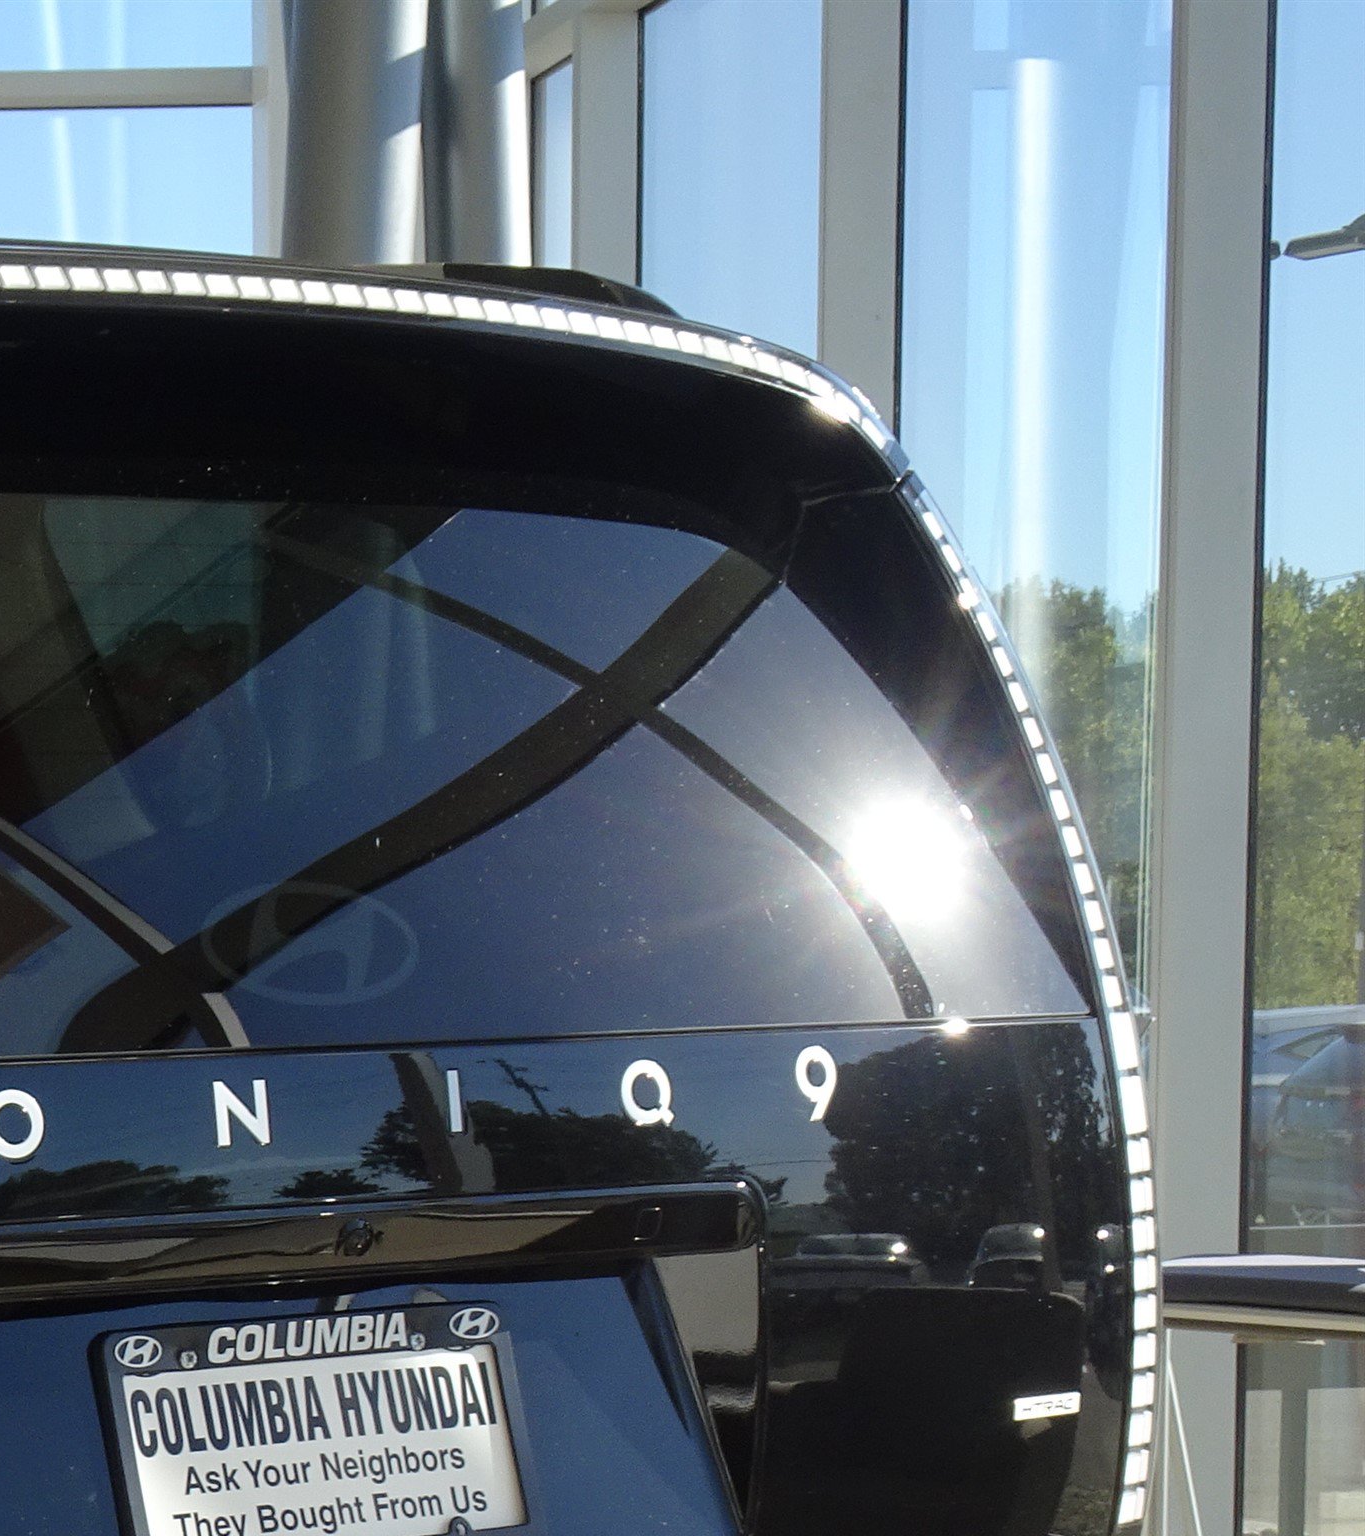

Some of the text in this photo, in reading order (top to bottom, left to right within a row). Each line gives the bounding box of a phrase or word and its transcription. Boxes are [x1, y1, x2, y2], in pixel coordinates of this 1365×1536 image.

[795, 1045, 838, 1122] 9
[207, 1312, 410, 1365] COLUMBIA
[129, 1360, 498, 1459] COLUMBIA HYUNDAI
[184, 1444, 466, 1496] Ask Your Neighbors
[259, 1495, 367, 1535] Bought
[373, 1492, 445, 1522] From
[450, 1484, 488, 1515] Us
